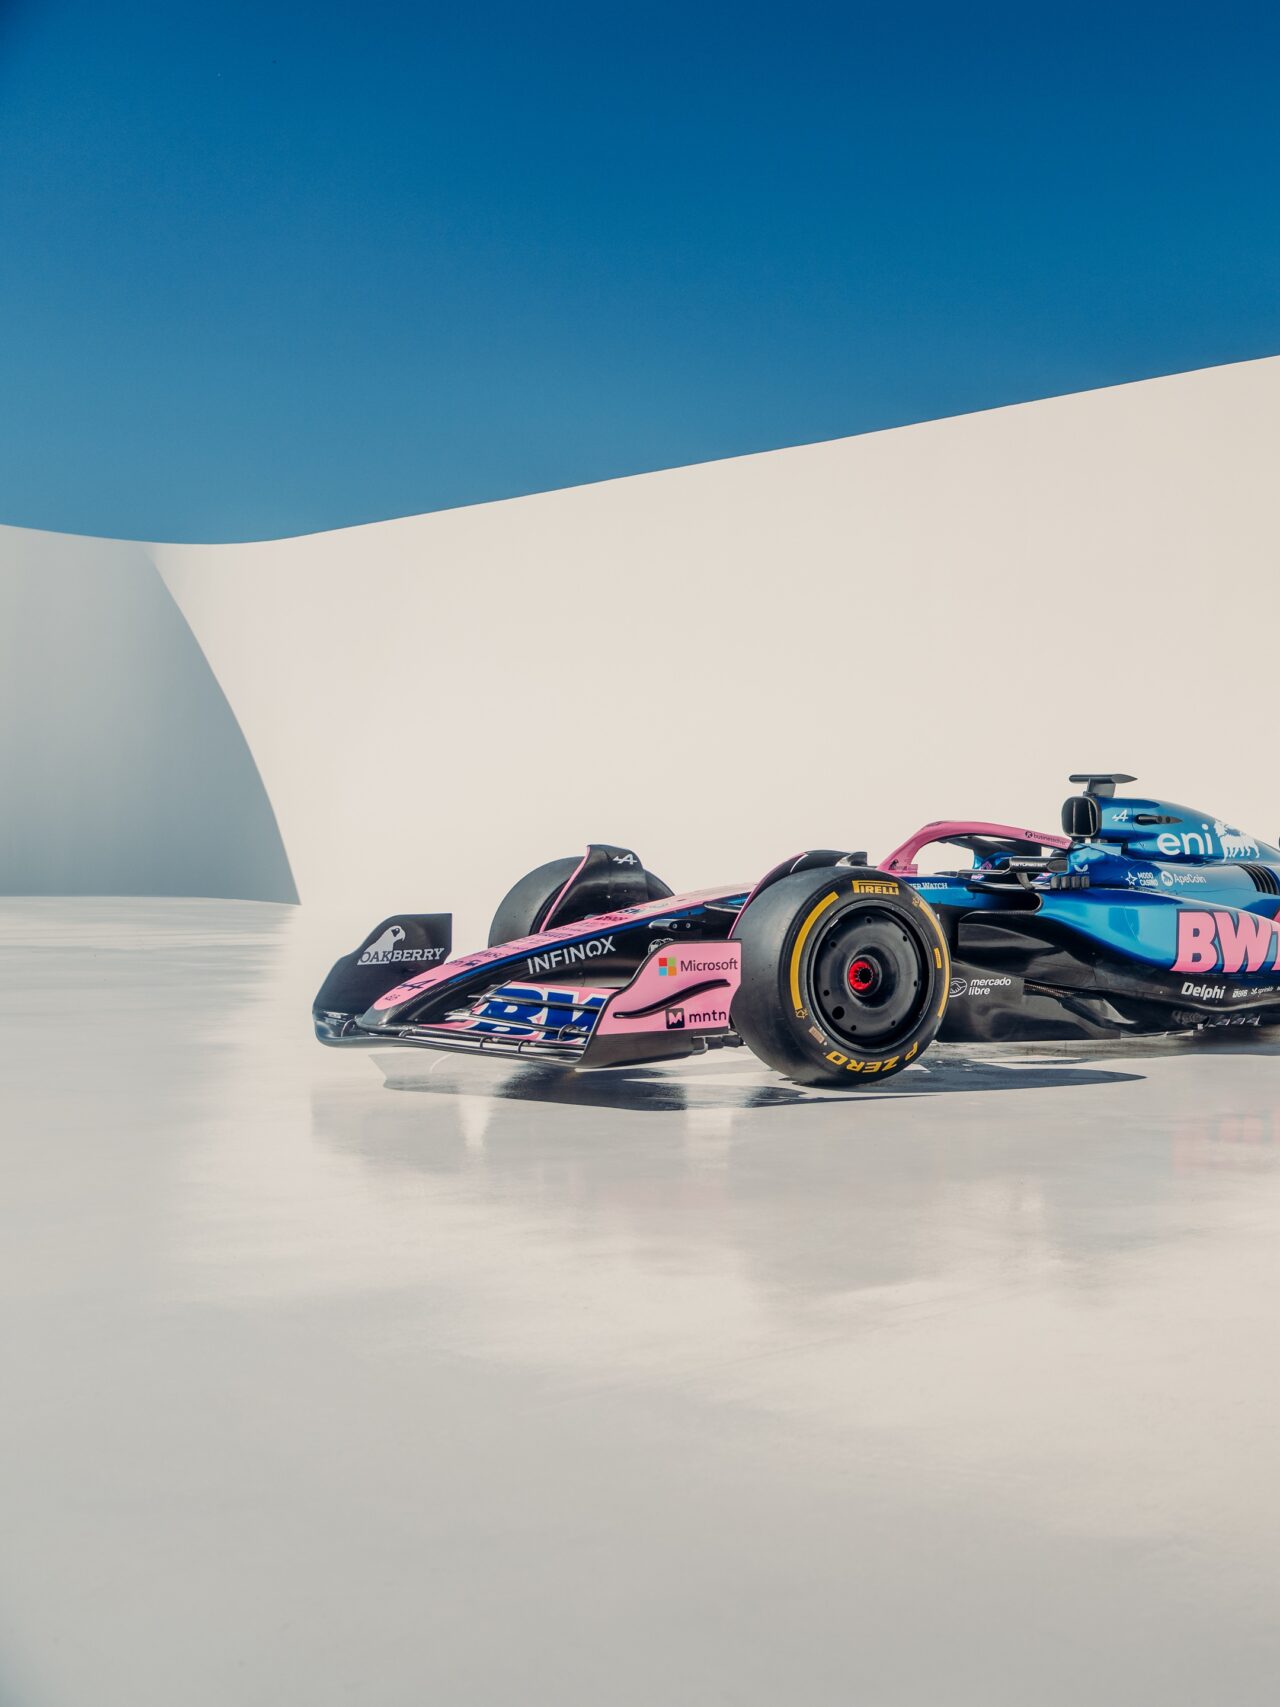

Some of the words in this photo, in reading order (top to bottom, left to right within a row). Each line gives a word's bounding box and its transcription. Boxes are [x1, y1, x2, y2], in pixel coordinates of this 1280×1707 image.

[1157, 824, 1212, 856] eni
[1174, 873, 1207, 885] ApeCoin
[852, 880, 899, 895] PIRELLI
[361, 948, 444, 963] OAKBERRY
[526, 936, 616, 974] INFINOX
[680, 958, 738, 972] Microsoft
[970, 977, 1011, 986] mercado
[968, 987, 990, 995] libre
[1181, 982, 1226, 1000] Delphi
[688, 1010, 727, 1023] mntn
[904, 1041, 920, 1060] P
[825, 1050, 898, 1073] ZERO
